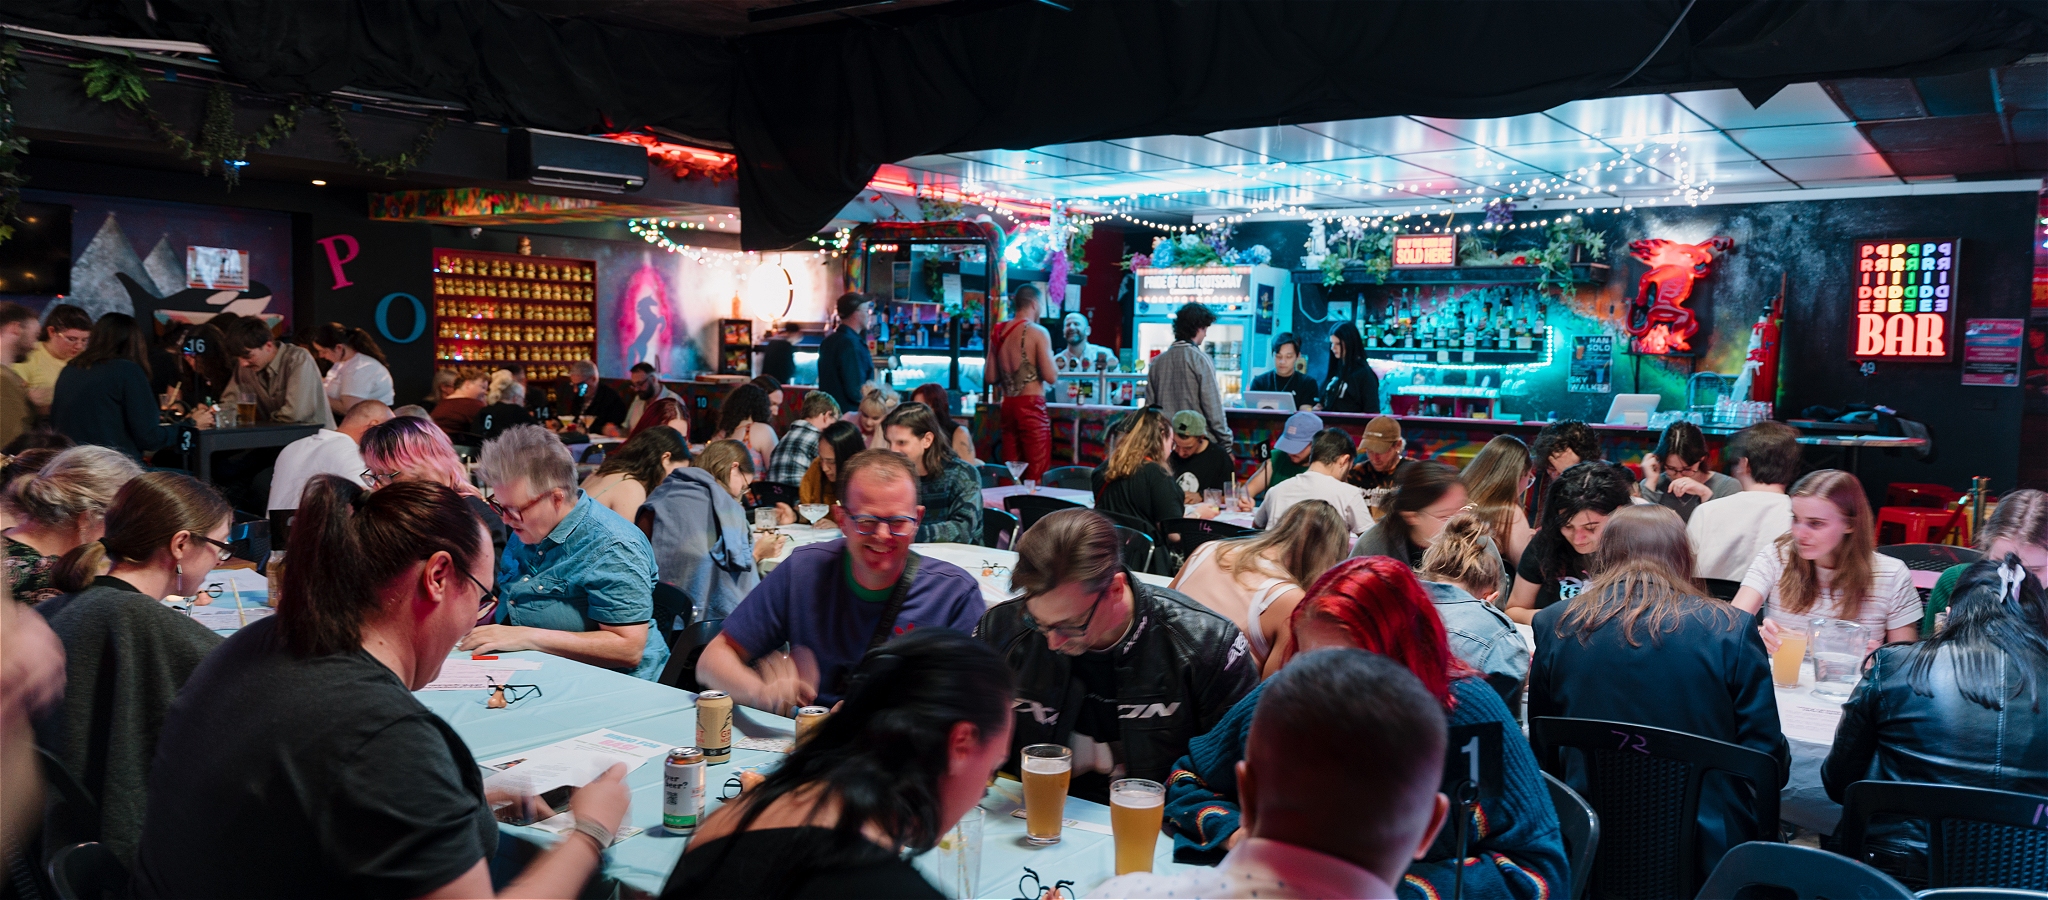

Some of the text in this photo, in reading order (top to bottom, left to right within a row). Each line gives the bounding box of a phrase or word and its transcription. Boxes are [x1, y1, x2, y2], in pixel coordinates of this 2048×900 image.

[316, 234, 360, 290] P
[1396, 247, 1452, 264] SOLD HERE
[1144, 274, 1243, 289] PRIDE OF OUR FOOTSCRAY
[375, 292, 427, 343] O
[1855, 313, 1946, 356] BAR
[187, 338, 205, 353] 16
[1860, 362, 1876, 376] 49
[1570, 383, 1611, 392] WALKER
[697, 397, 707, 408] 10
[535, 407, 549, 419] 14
[484, 415, 492, 429] 6
[181, 431, 192, 450] 3
[1261, 443, 1268, 458] 8
[1610, 730, 1651, 754] 72
[1461, 736, 1479, 788] 1
